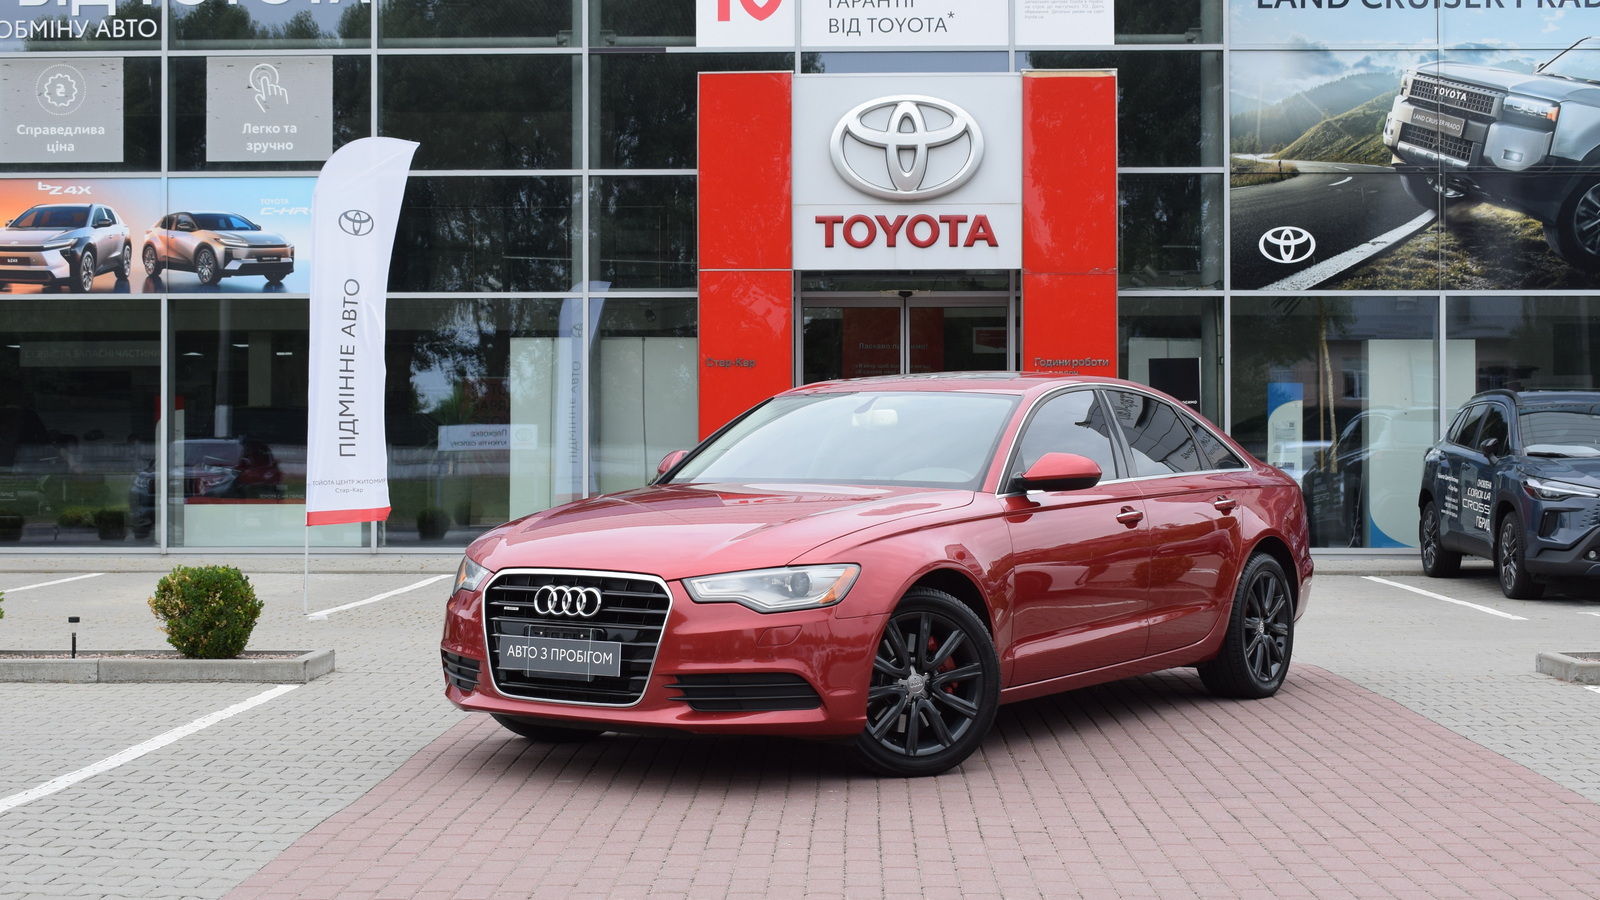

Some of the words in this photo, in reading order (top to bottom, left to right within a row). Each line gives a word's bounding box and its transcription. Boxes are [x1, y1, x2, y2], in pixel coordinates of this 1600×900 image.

[0, 19, 89, 39] ОБМІНУ
[95, 19, 158, 38] АВТО
[828, 18, 861, 36] ВІД
[1434, 87, 1466, 101] TOYOTA
[242, 122, 279, 135] Легко
[282, 124, 298, 135] та
[1413, 113, 1426, 122] LAND
[1445, 120, 1460, 130] PRADO
[16, 123, 106, 138] Справедлива
[46, 140, 76, 154] ціна
[246, 141, 294, 154] зручно
[815, 213, 999, 249] TOYOTA
[341, 278, 360, 338] АВТО
[705, 357, 757, 369] Стар-Кар
[1034, 357, 1071, 368] Години
[1071, 357, 1109, 369] роботи
[339, 345, 360, 457] ПІДМІННЕ
[1467, 487, 1491, 501] COROLLA
[1462, 498, 1490, 514] CROSS
[507, 644, 538, 659] АВТО
[550, 648, 613, 665] ПРОБІГОМ
